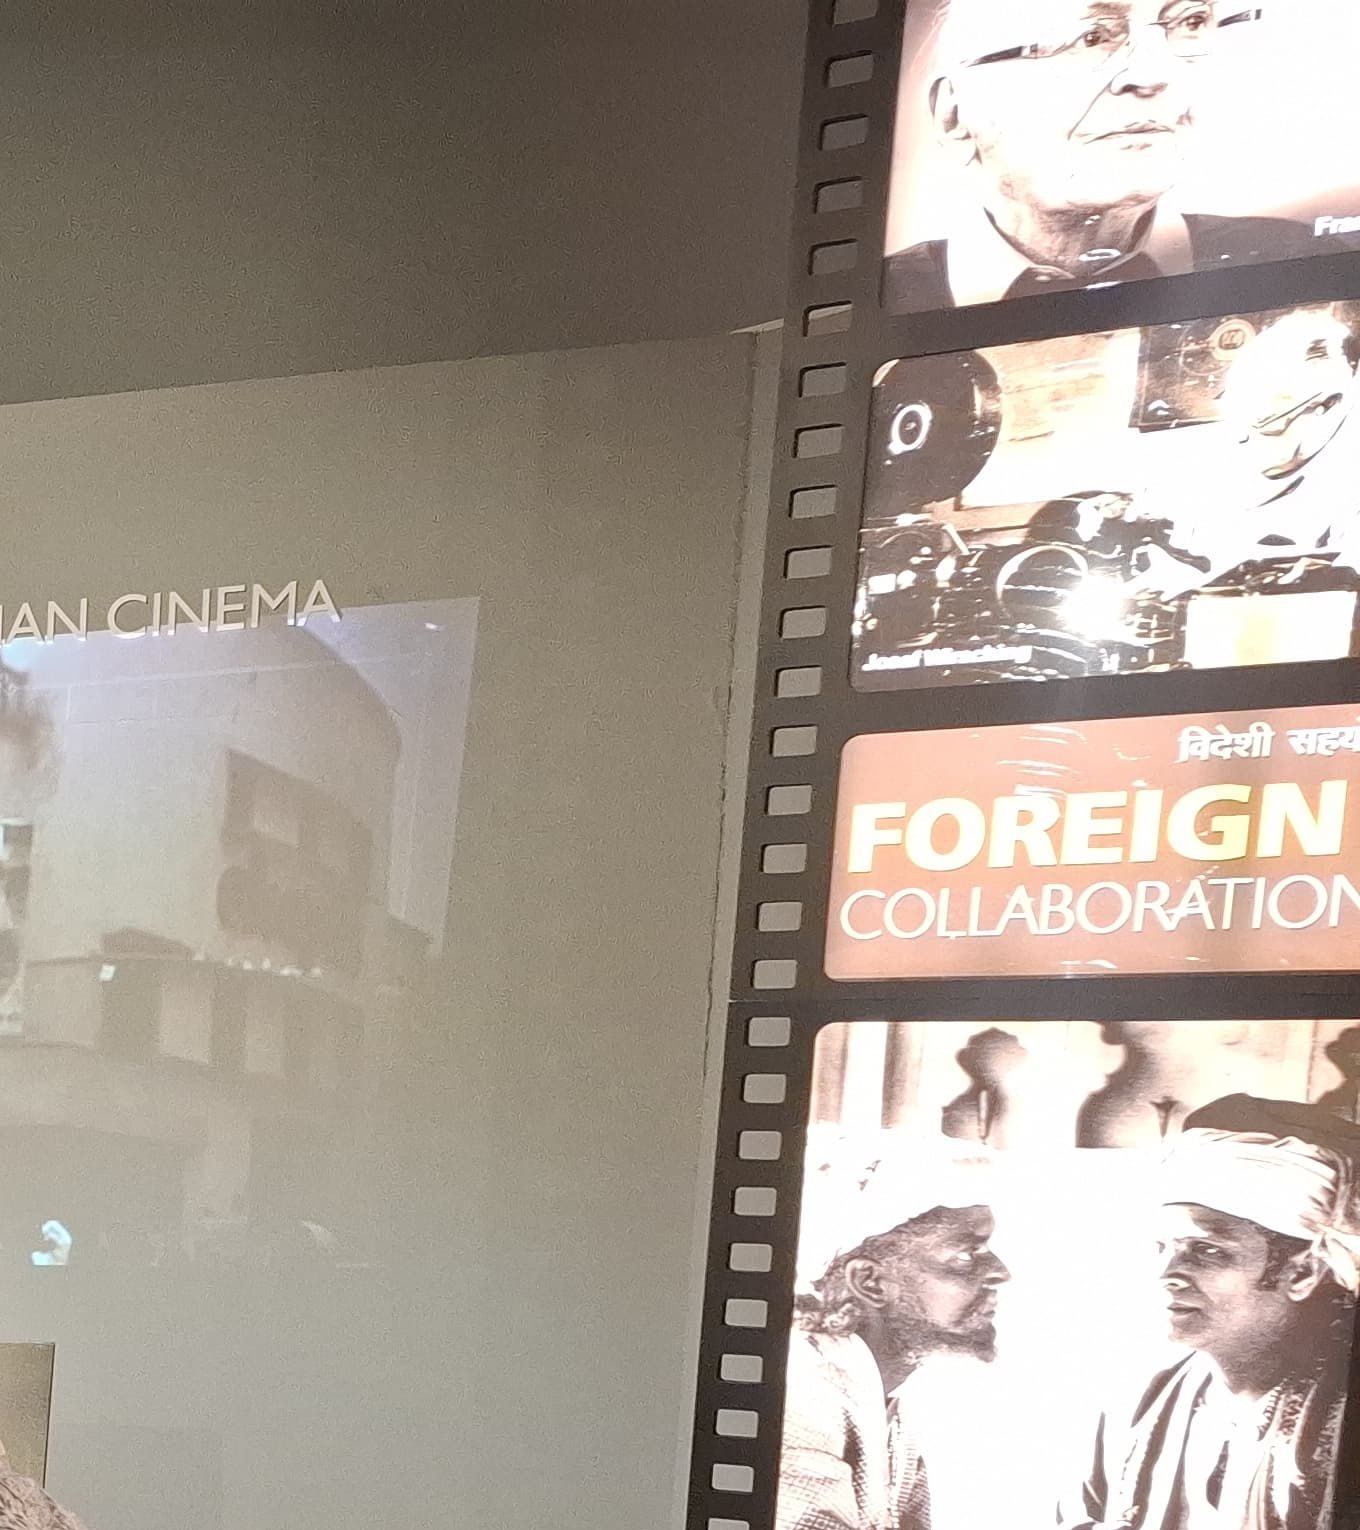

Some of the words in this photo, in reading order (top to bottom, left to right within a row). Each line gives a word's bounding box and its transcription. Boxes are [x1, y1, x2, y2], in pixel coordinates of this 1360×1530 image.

[107, 578, 343, 641] CINEMA
[1174, 720, 1275, 764] विदेशी
[847, 779, 1348, 874] FOREIGN
